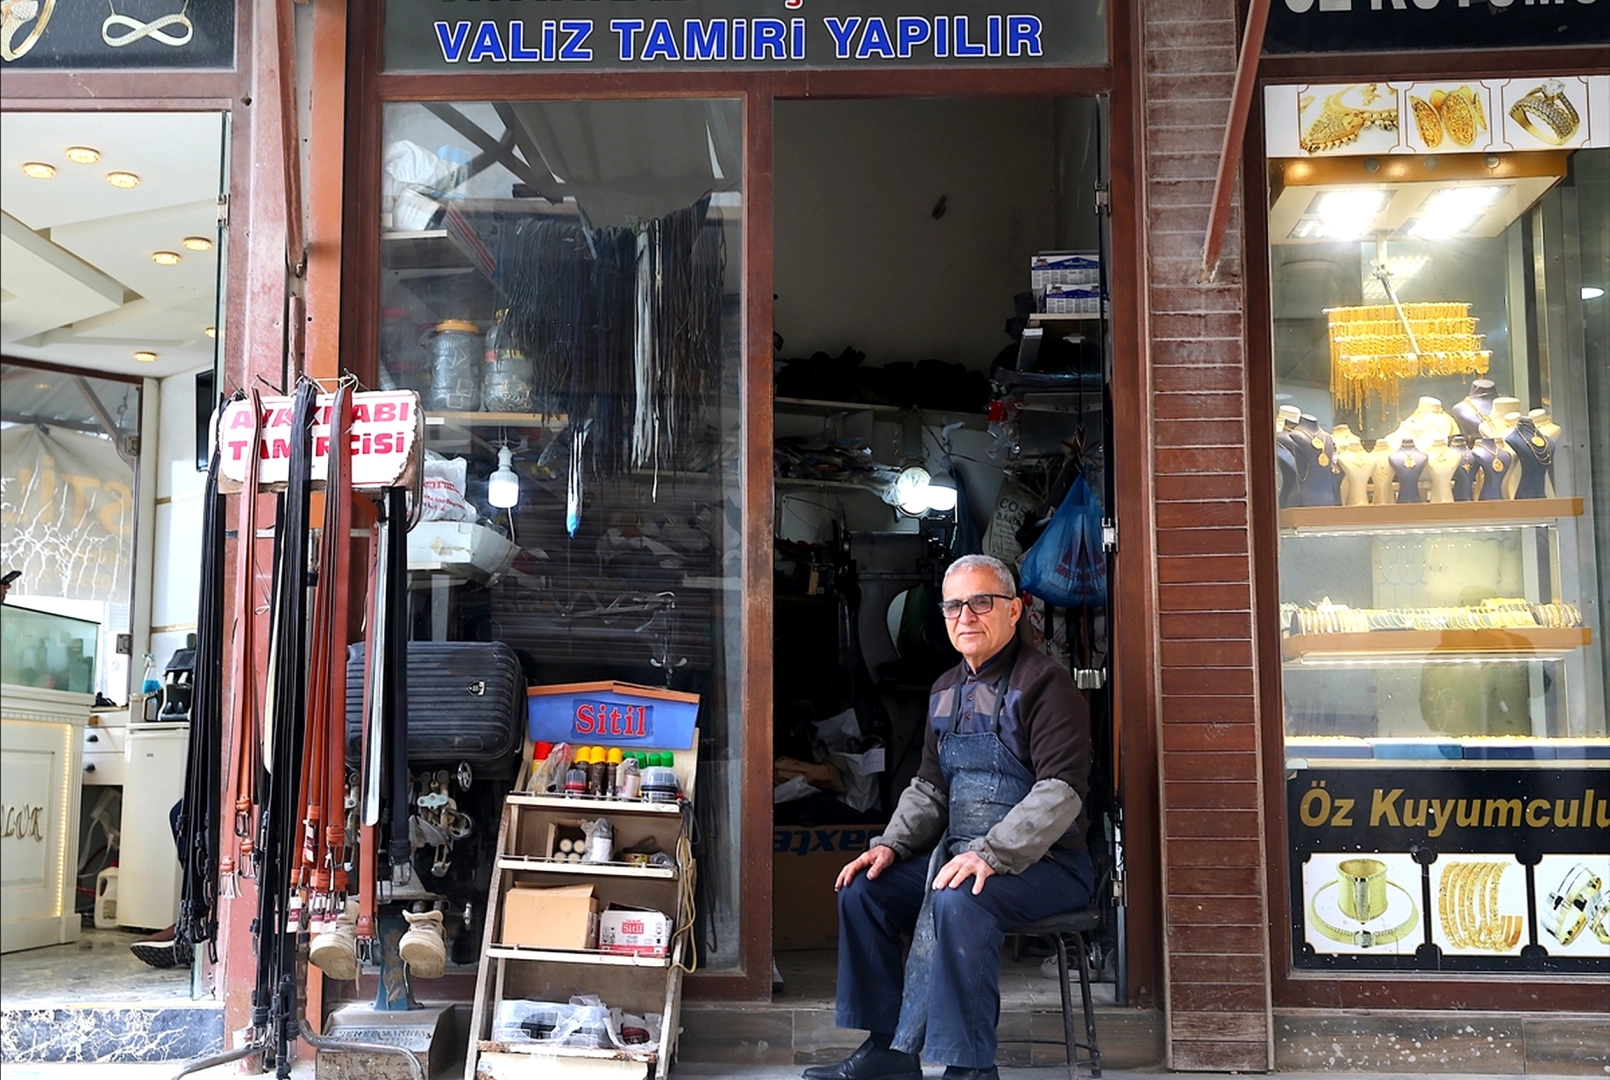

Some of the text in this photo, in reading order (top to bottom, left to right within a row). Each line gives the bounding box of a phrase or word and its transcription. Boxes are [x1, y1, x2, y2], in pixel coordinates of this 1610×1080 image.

[823, 15, 1044, 59] YAPILIR
[229, 402, 410, 430] AYAABI
[575, 703, 647, 736] Sitil
[1299, 780, 1356, 828] Öz
[774, 828, 884, 857] axte
